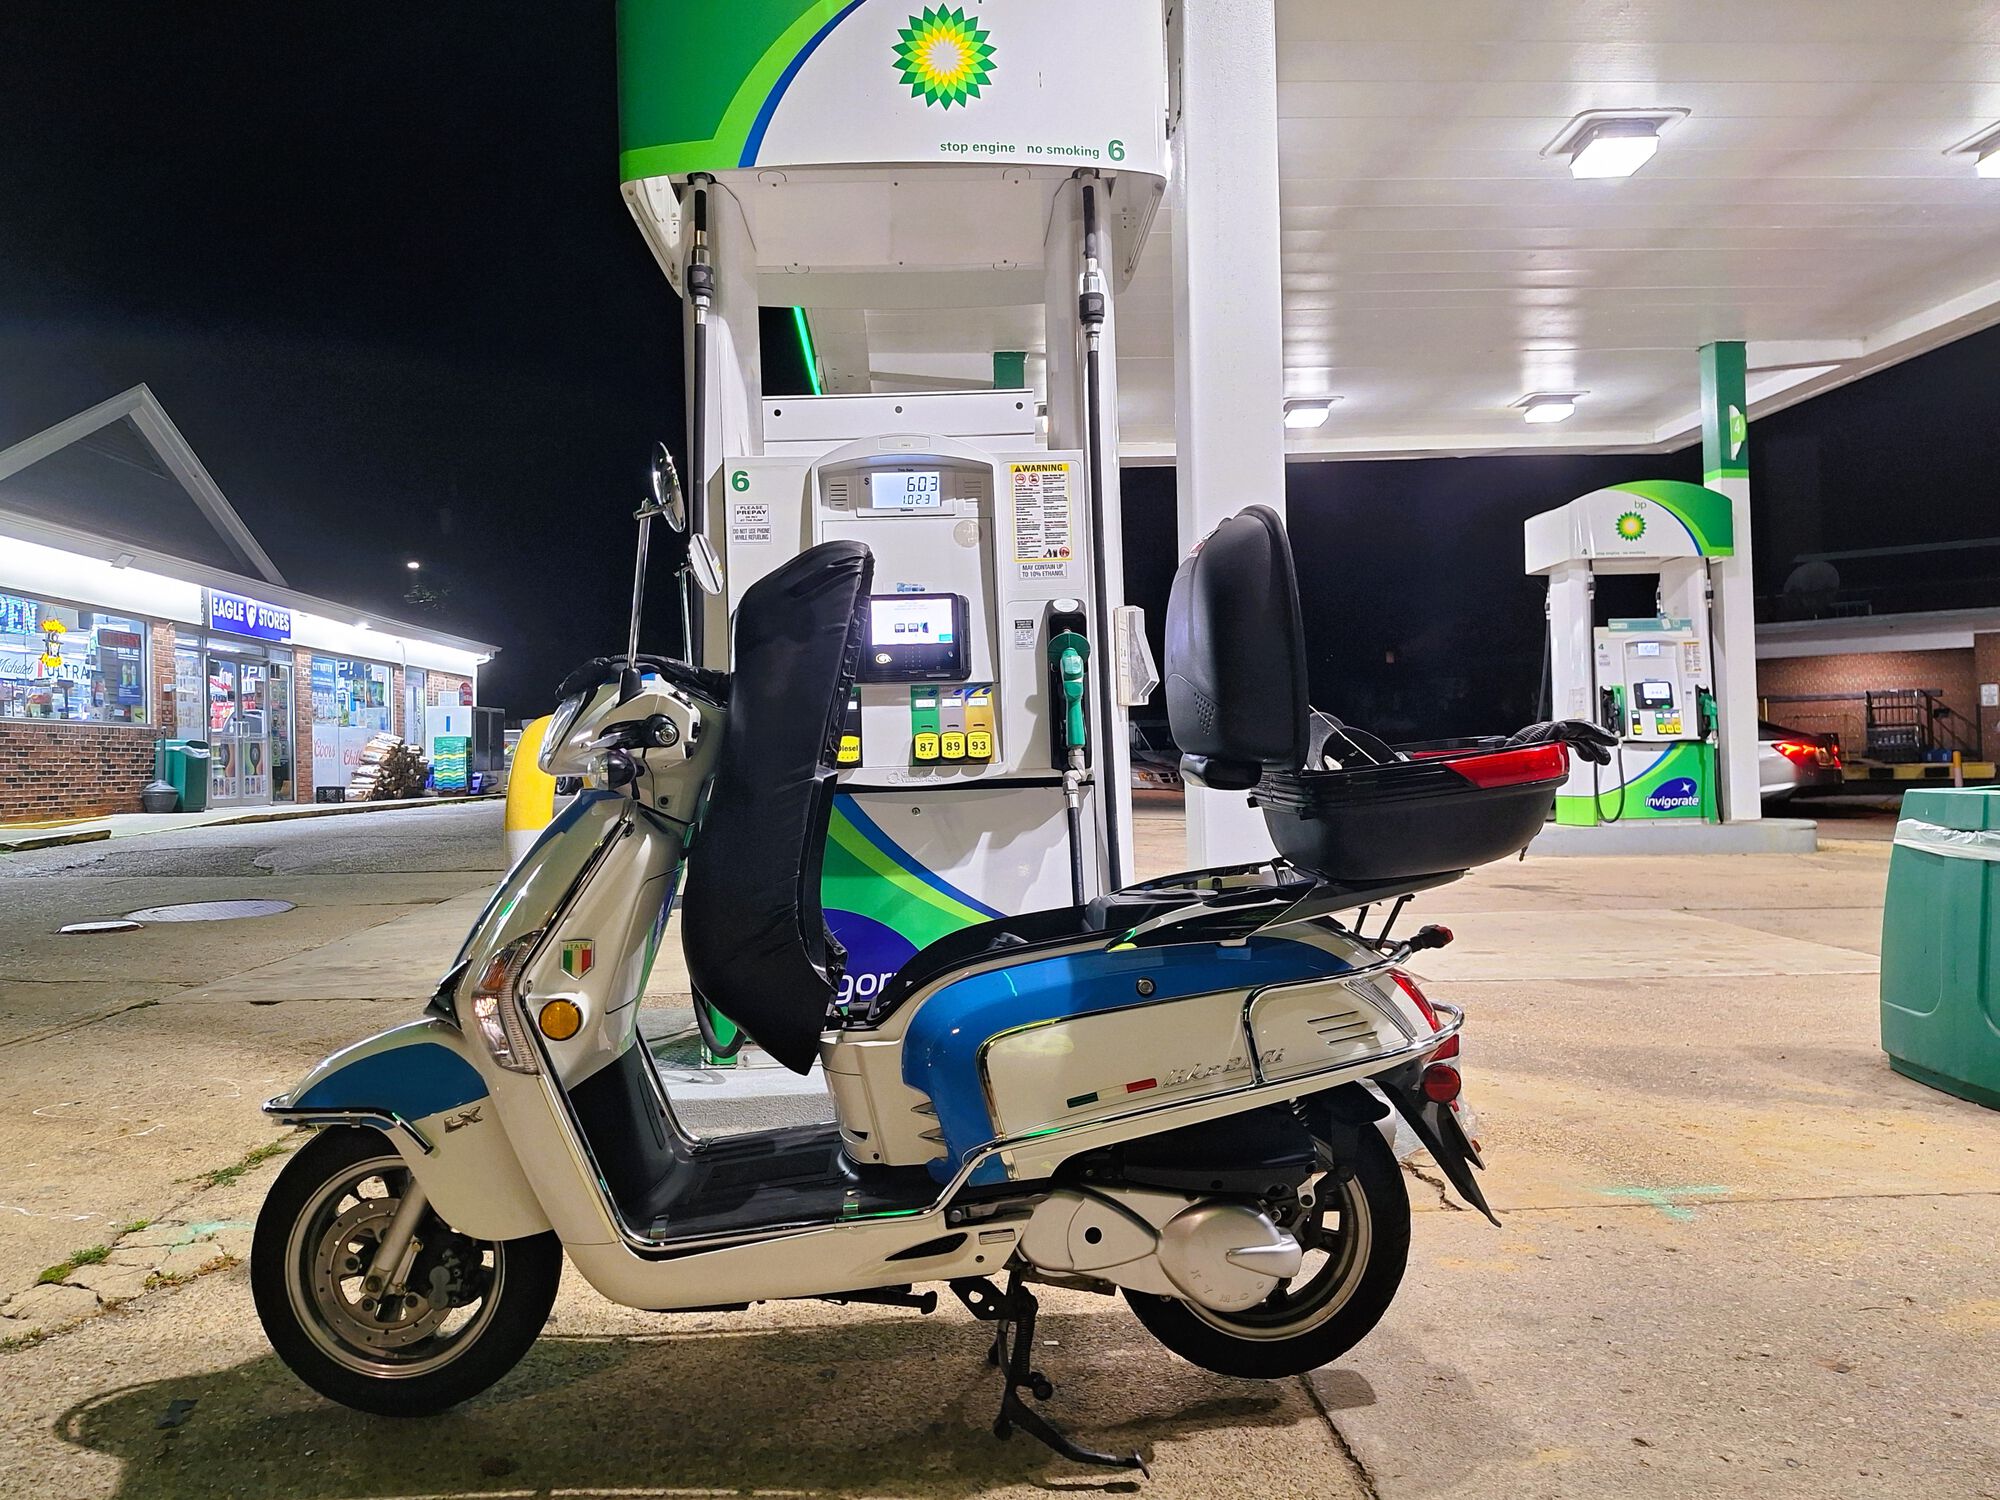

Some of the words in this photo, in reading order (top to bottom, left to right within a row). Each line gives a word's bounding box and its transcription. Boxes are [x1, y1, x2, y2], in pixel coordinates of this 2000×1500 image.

[940, 142, 968, 154] stop
[972, 142, 1015, 155] engine
[1027, 144, 1043, 154] no
[1046, 145, 1100, 159] smoking
[1108, 139, 1125, 161] 6
[1021, 464, 1063, 472] WARNING
[731, 470, 750, 492] 6
[906, 476, 938, 492] 6.03
[902, 494, 931, 505] 1.023
[1634, 501, 1647, 509] bp
[213, 596, 244, 622] EAGLE
[259, 608, 290, 631] STORES
[314, 738, 336, 758] Coors
[919, 742, 934, 752] 87
[946, 741, 960, 751] 89
[972, 741, 986, 750] 93
[444, 1106, 484, 1133] LX
